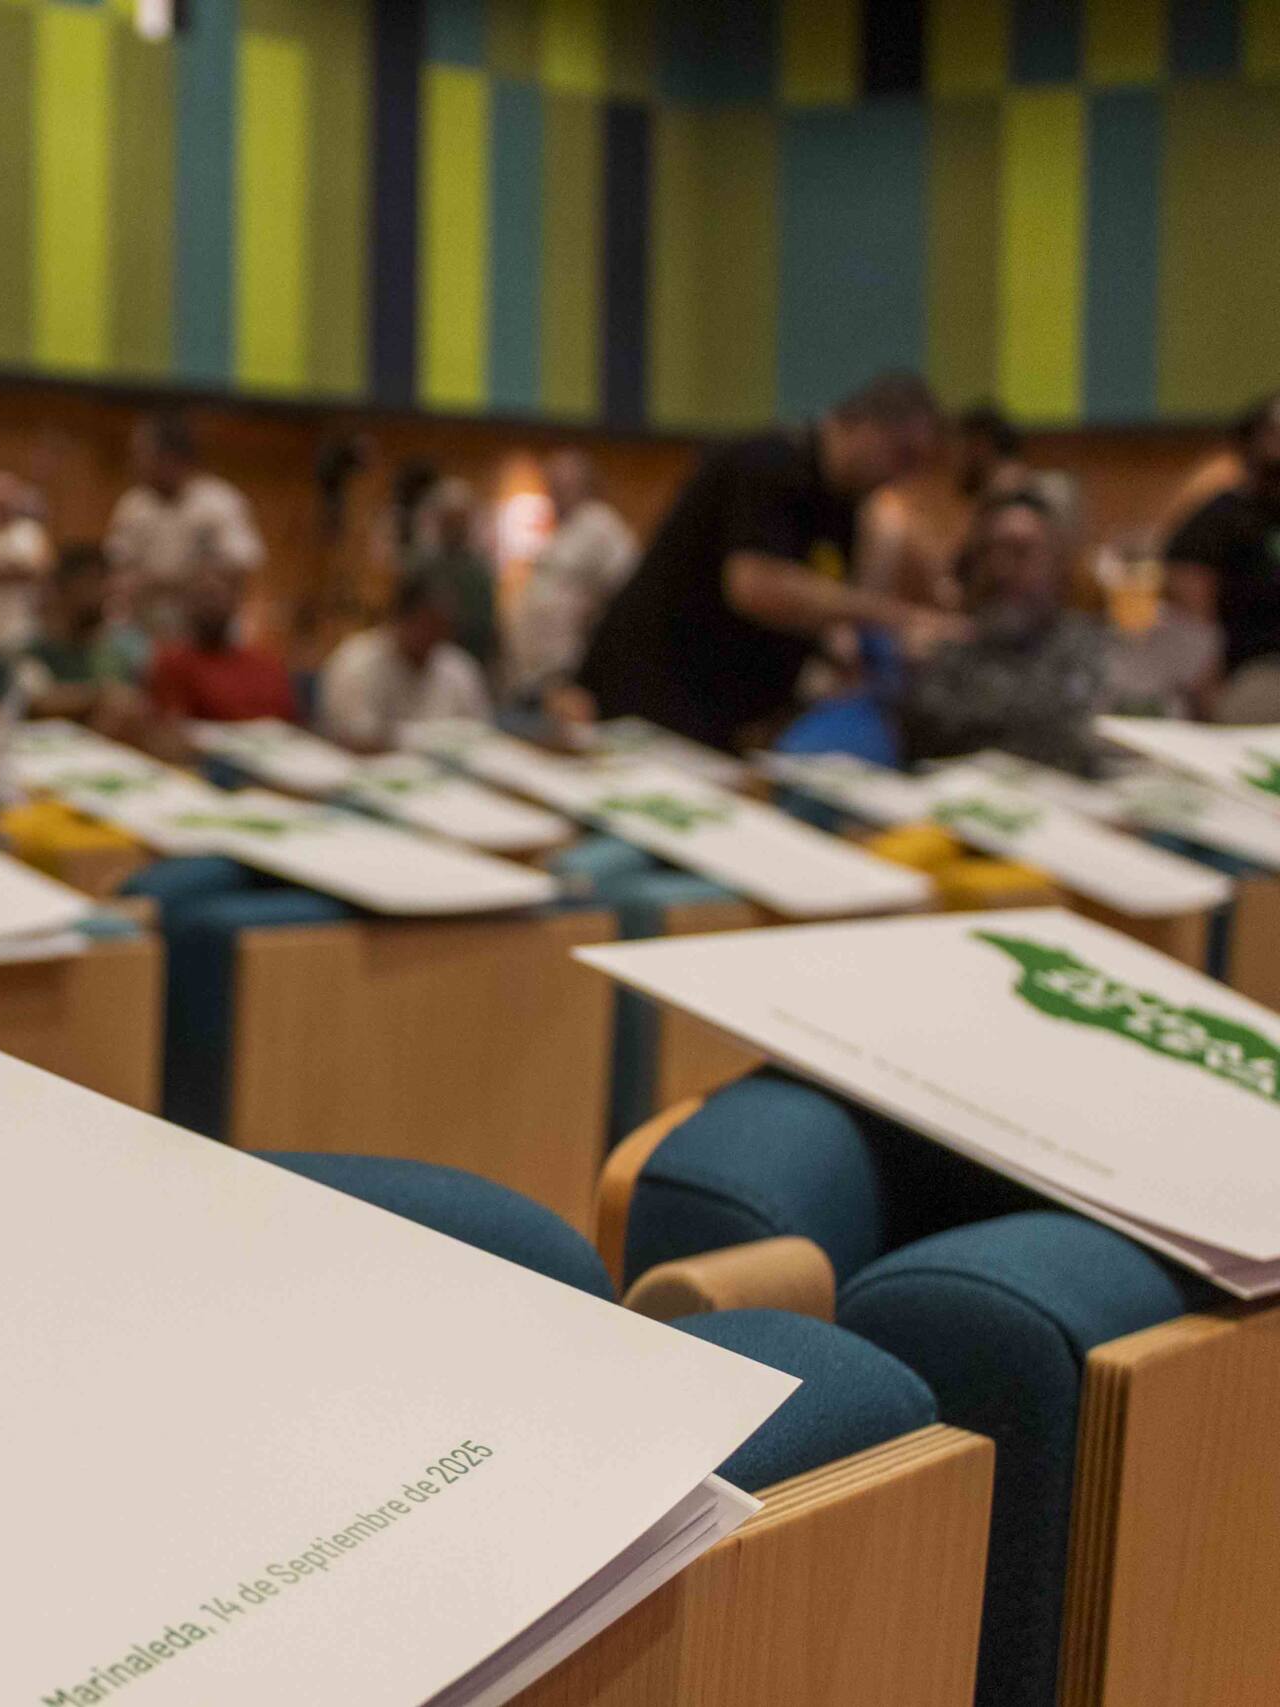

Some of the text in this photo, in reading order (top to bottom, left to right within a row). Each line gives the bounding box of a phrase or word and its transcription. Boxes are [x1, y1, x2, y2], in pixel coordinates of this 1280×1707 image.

[199, 1597, 246, 1623] 14
[237, 1578, 280, 1605] de
[265, 1499, 412, 1585] Septiembre
[401, 1479, 441, 1504] de
[425, 1439, 494, 1485] 2025
